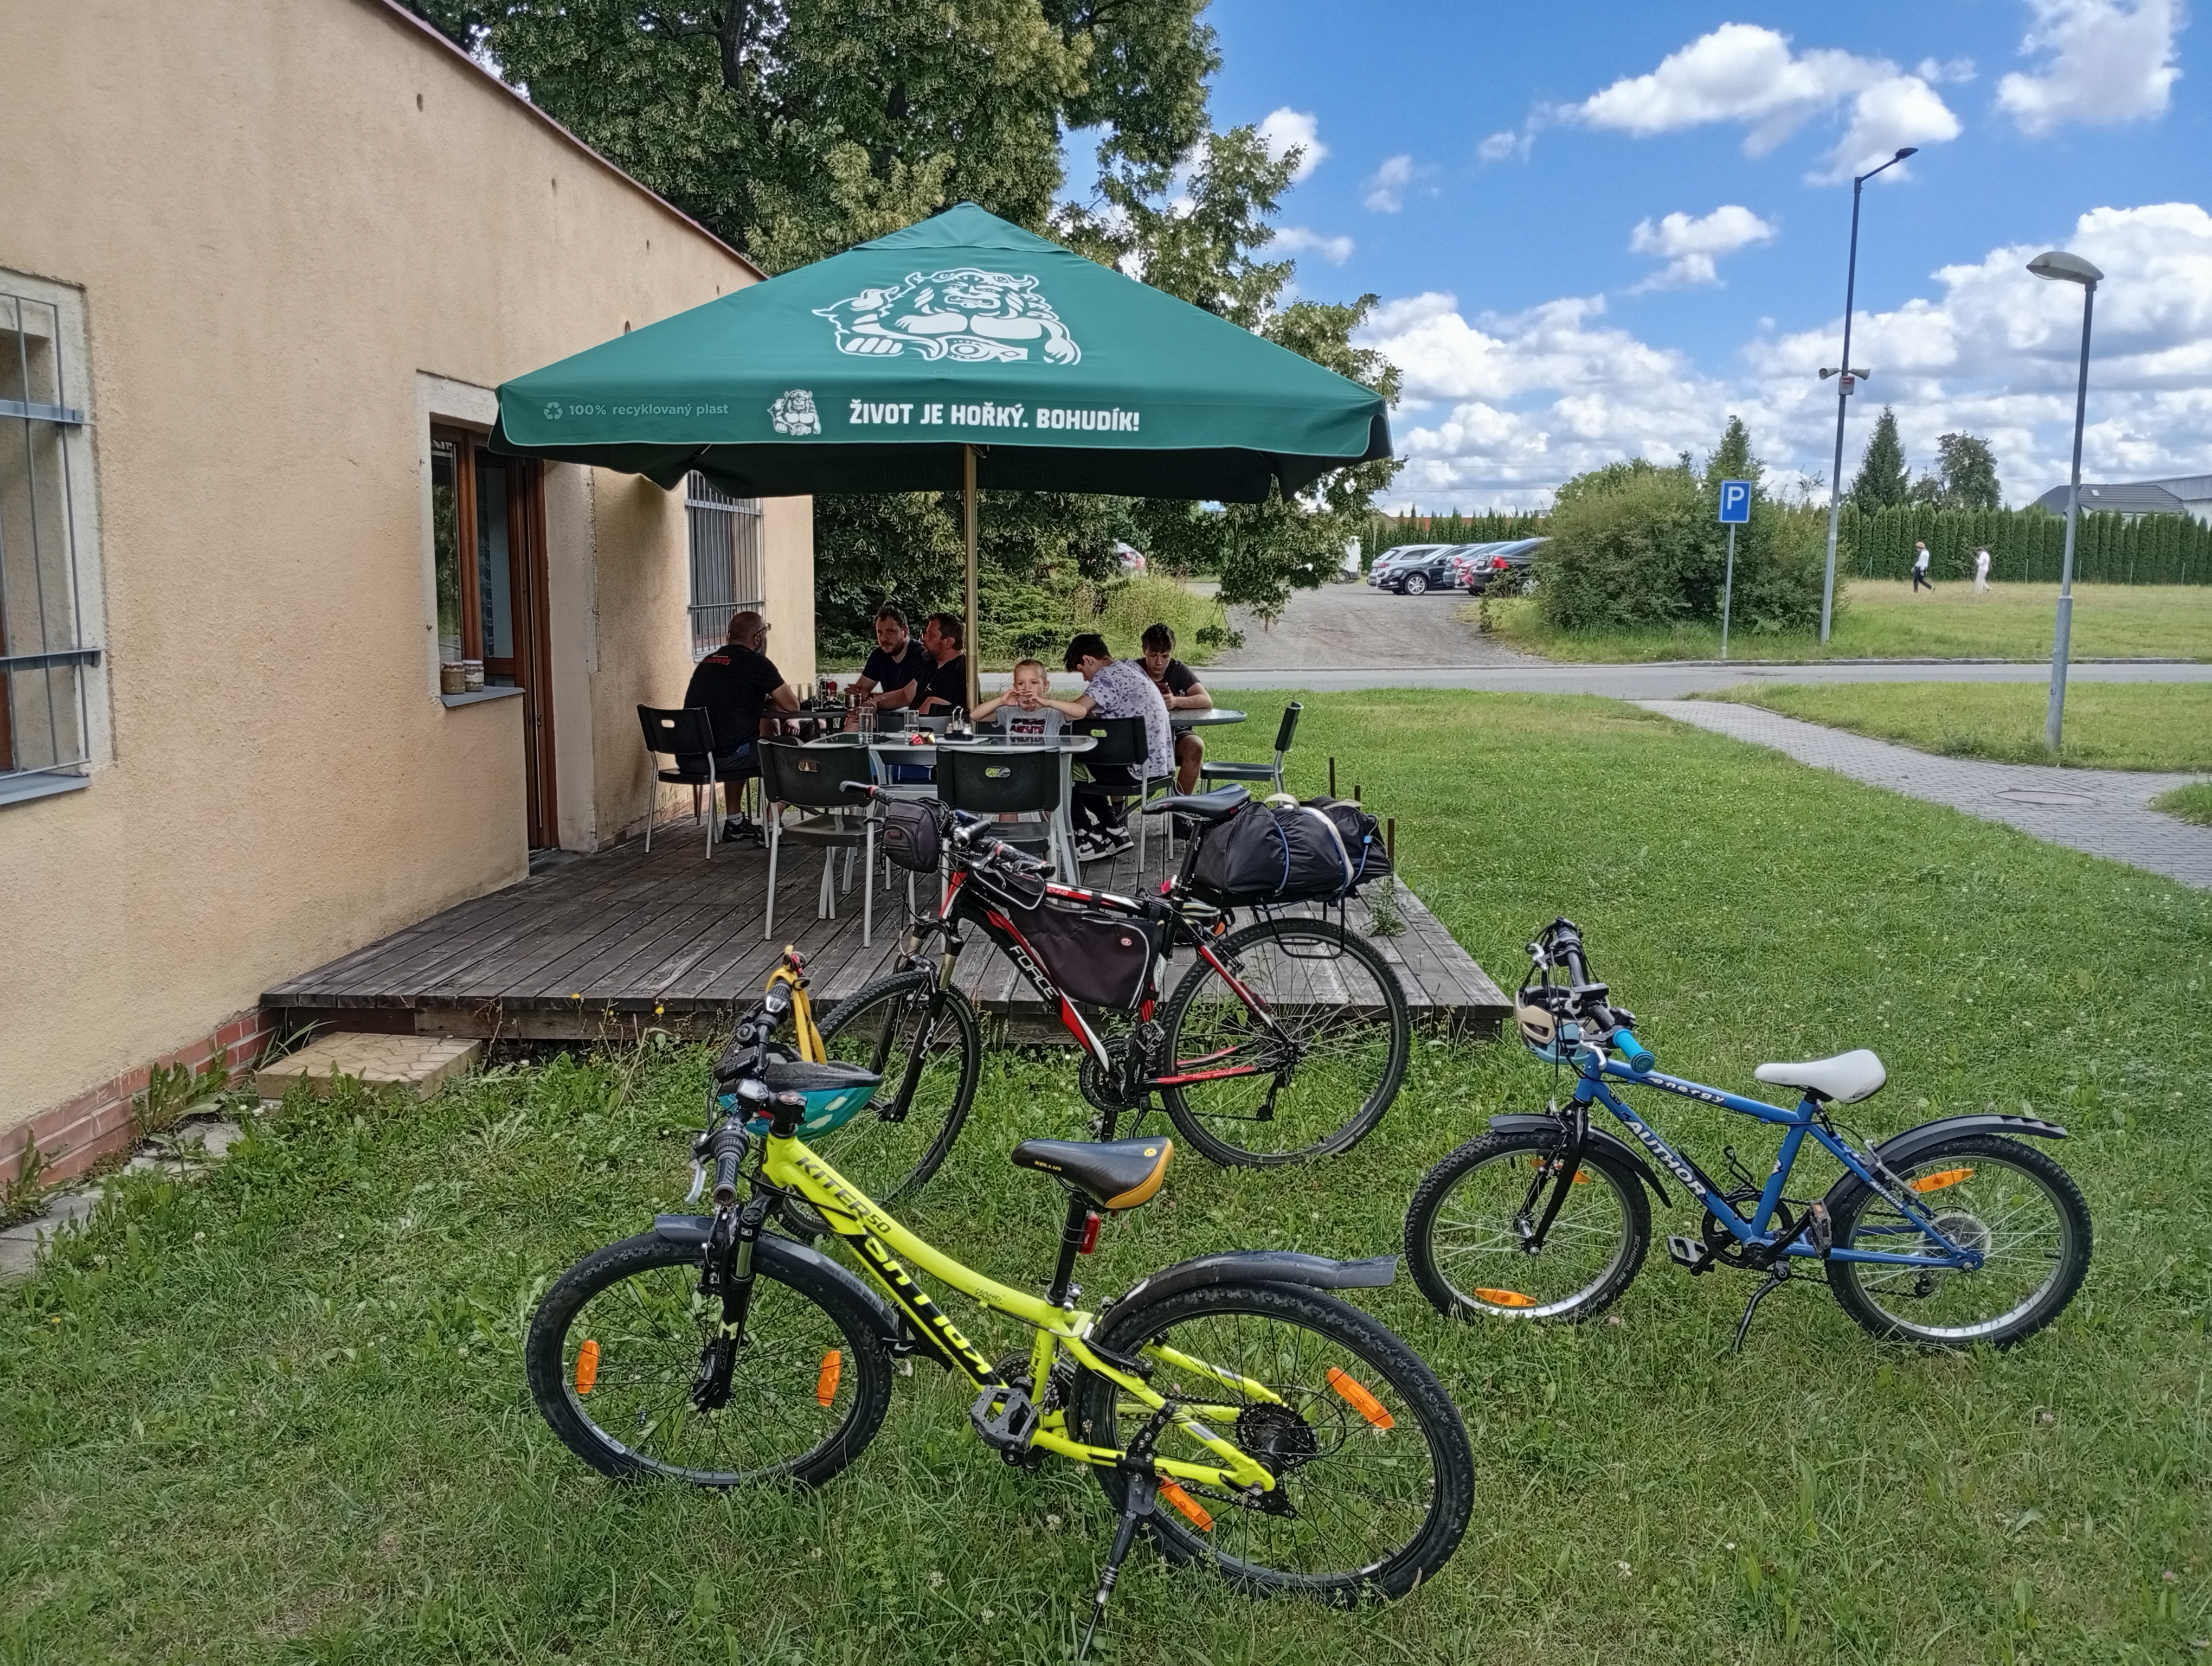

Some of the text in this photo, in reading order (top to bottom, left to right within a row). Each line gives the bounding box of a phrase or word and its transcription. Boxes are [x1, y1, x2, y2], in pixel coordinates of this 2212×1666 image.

[569, 403, 729, 416] 100% recyklovaný plast
[849, 399, 1140, 432] ŽIVOT JE HOŘKÝ. BOHUDÍK!
[1727, 486, 1745, 510] P
[1009, 945, 1059, 1000] FORCE
[1647, 1077, 1726, 1103] energy
[1625, 1120, 1707, 1196] AUTHOR
[1869, 1181, 1904, 1209] AUTHOR
[1615, 1233, 1641, 1286] SCHWALBE
